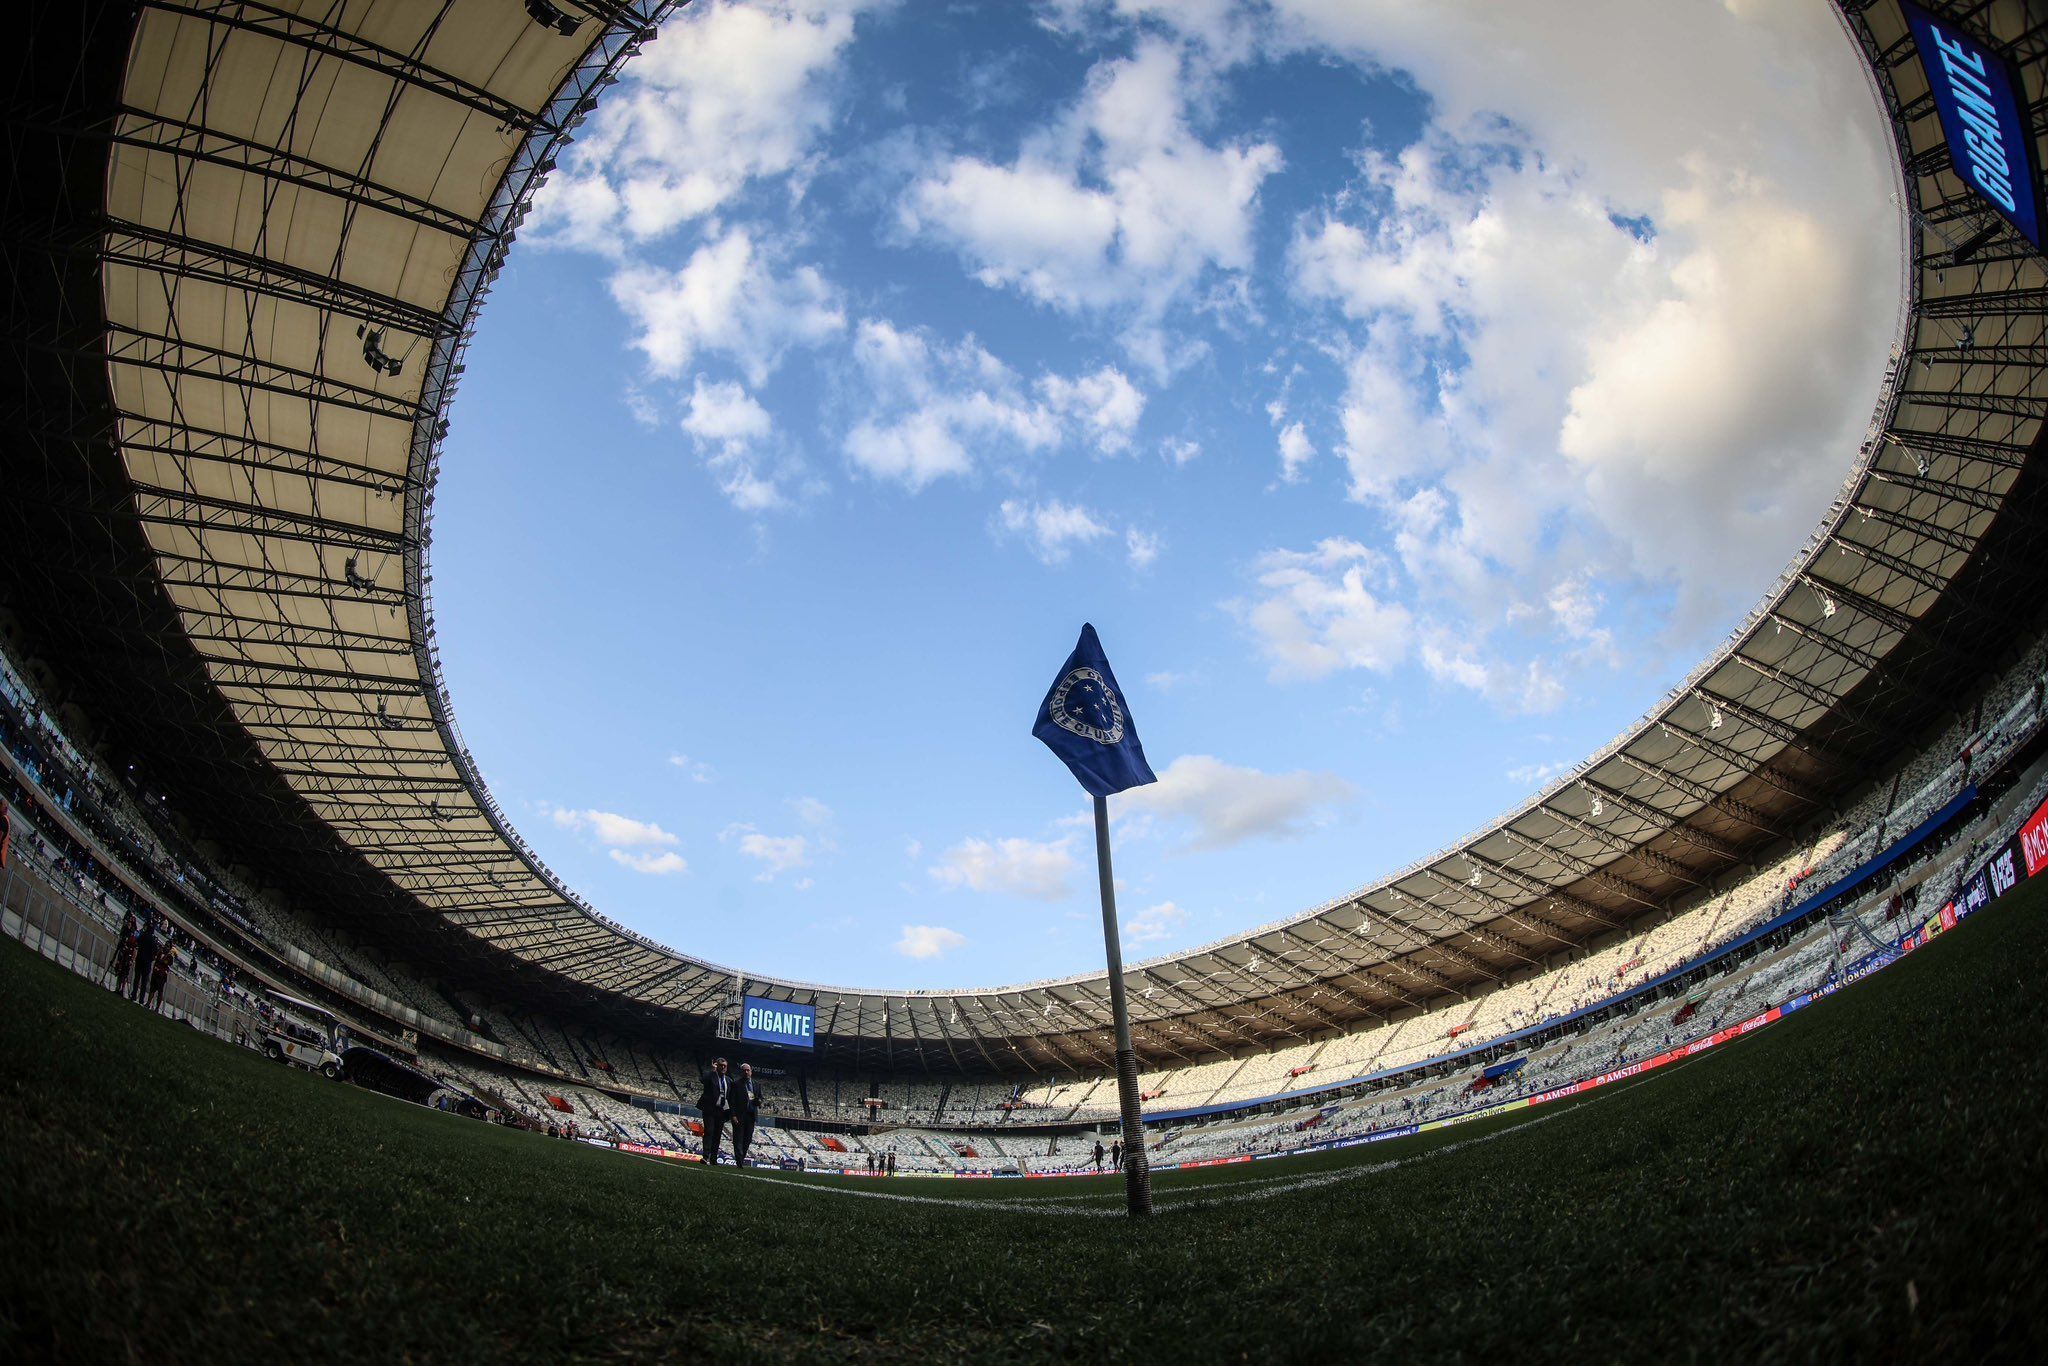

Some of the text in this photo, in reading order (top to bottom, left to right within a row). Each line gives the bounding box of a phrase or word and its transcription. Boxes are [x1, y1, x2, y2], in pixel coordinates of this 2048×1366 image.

[1931, 24, 2016, 212] GIGANTE
[1052, 673, 1117, 741] ESPORTE CLUBE
[2029, 824, 2047, 862] MG
[1807, 982, 1840, 1002] GRANDE
[748, 1008, 811, 1037] GIGANTE
[1742, 1013, 1767, 1033] Coca-Cola
[1688, 1037, 1713, 1054] Coca-Cola
[1452, 1106, 1506, 1125] mercado livre
[1341, 1129, 1411, 1149] CONMEBOL SUDAMERICANA
[628, 1144, 662, 1156] MG MOTOR
